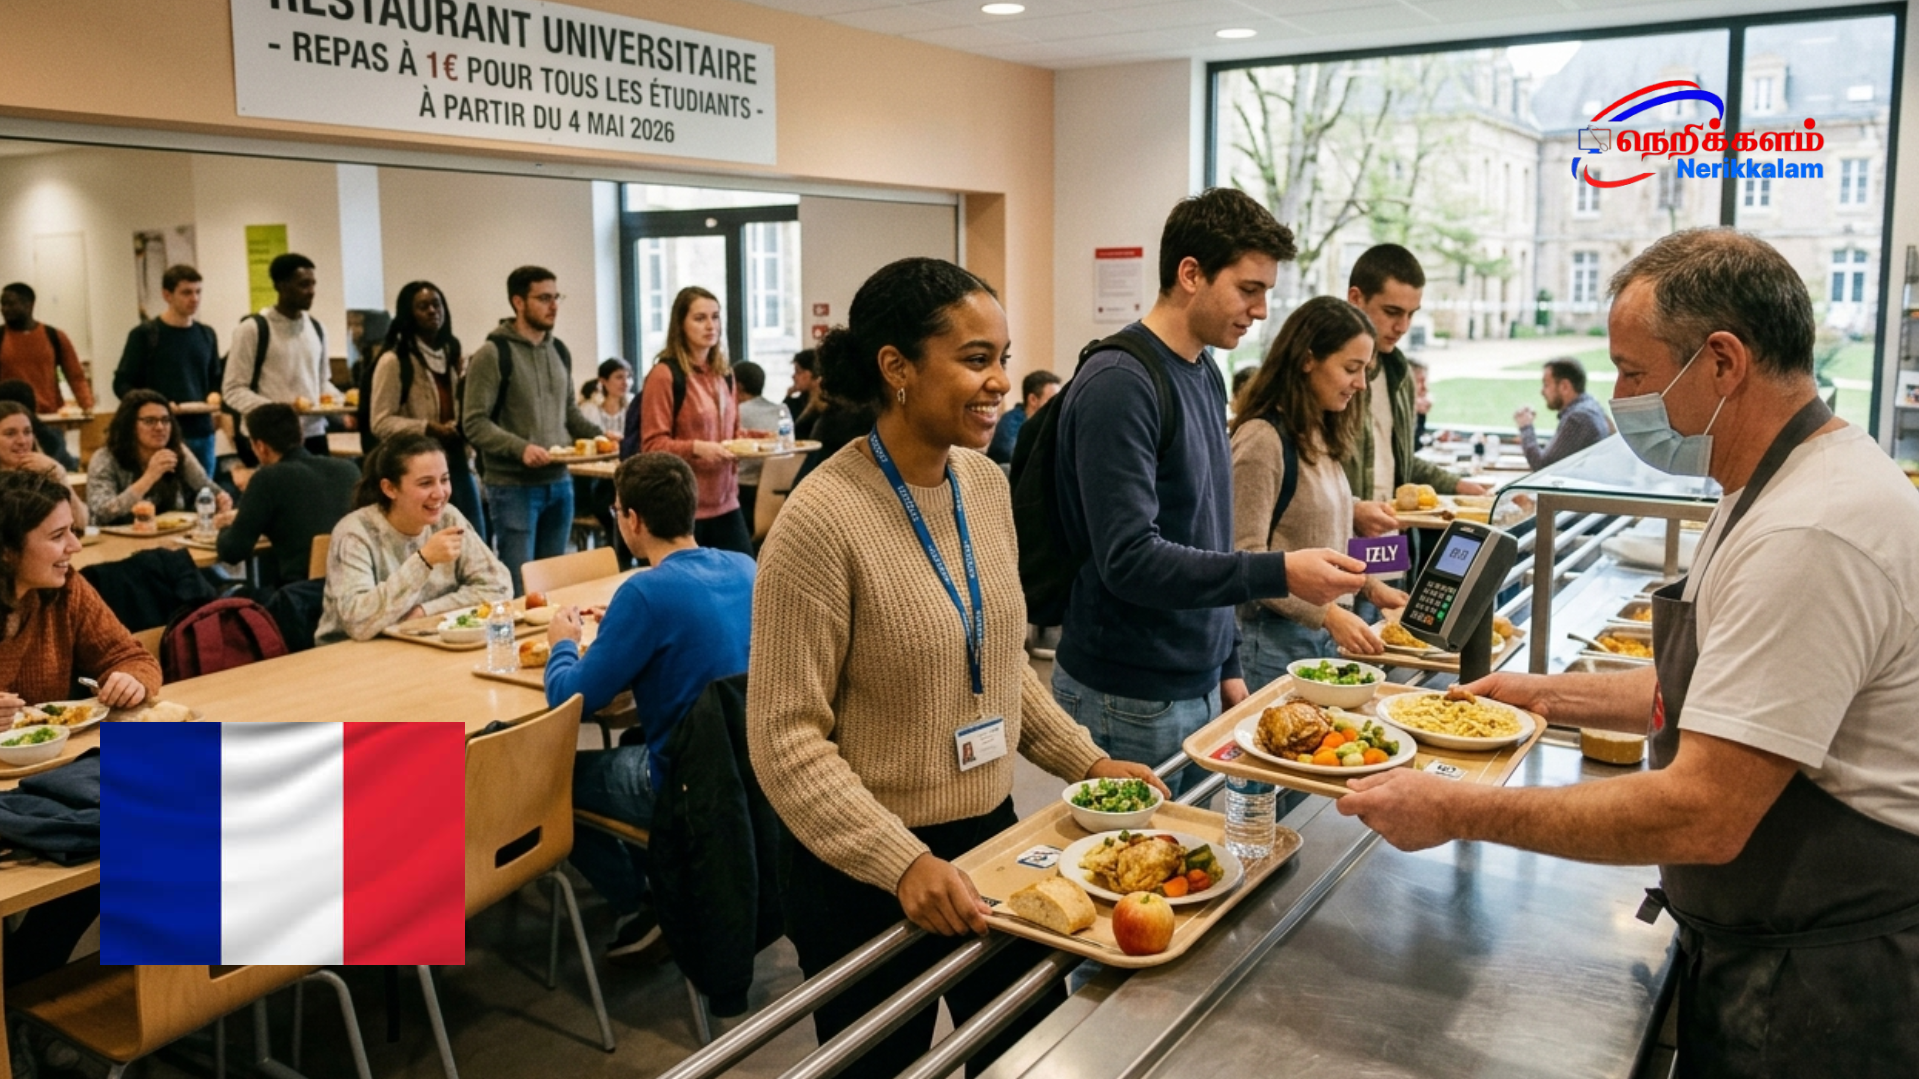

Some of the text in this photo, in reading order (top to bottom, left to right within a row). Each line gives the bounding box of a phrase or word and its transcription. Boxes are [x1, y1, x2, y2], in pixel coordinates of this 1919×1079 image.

[270, 0, 757, 85] STAURANT UNIVERSITAIRE
[293, 31, 389, 73] REPAS
[398, 39, 418, 77] À
[426, 51, 459, 82] 1€
[467, 56, 533, 91] POUR
[540, 67, 599, 100] TOUS
[605, 76, 643, 105] LES
[650, 77, 751, 120] ÉTUDIANTS
[419, 84, 675, 143] À PARTIR DU 4 MAI 2026
